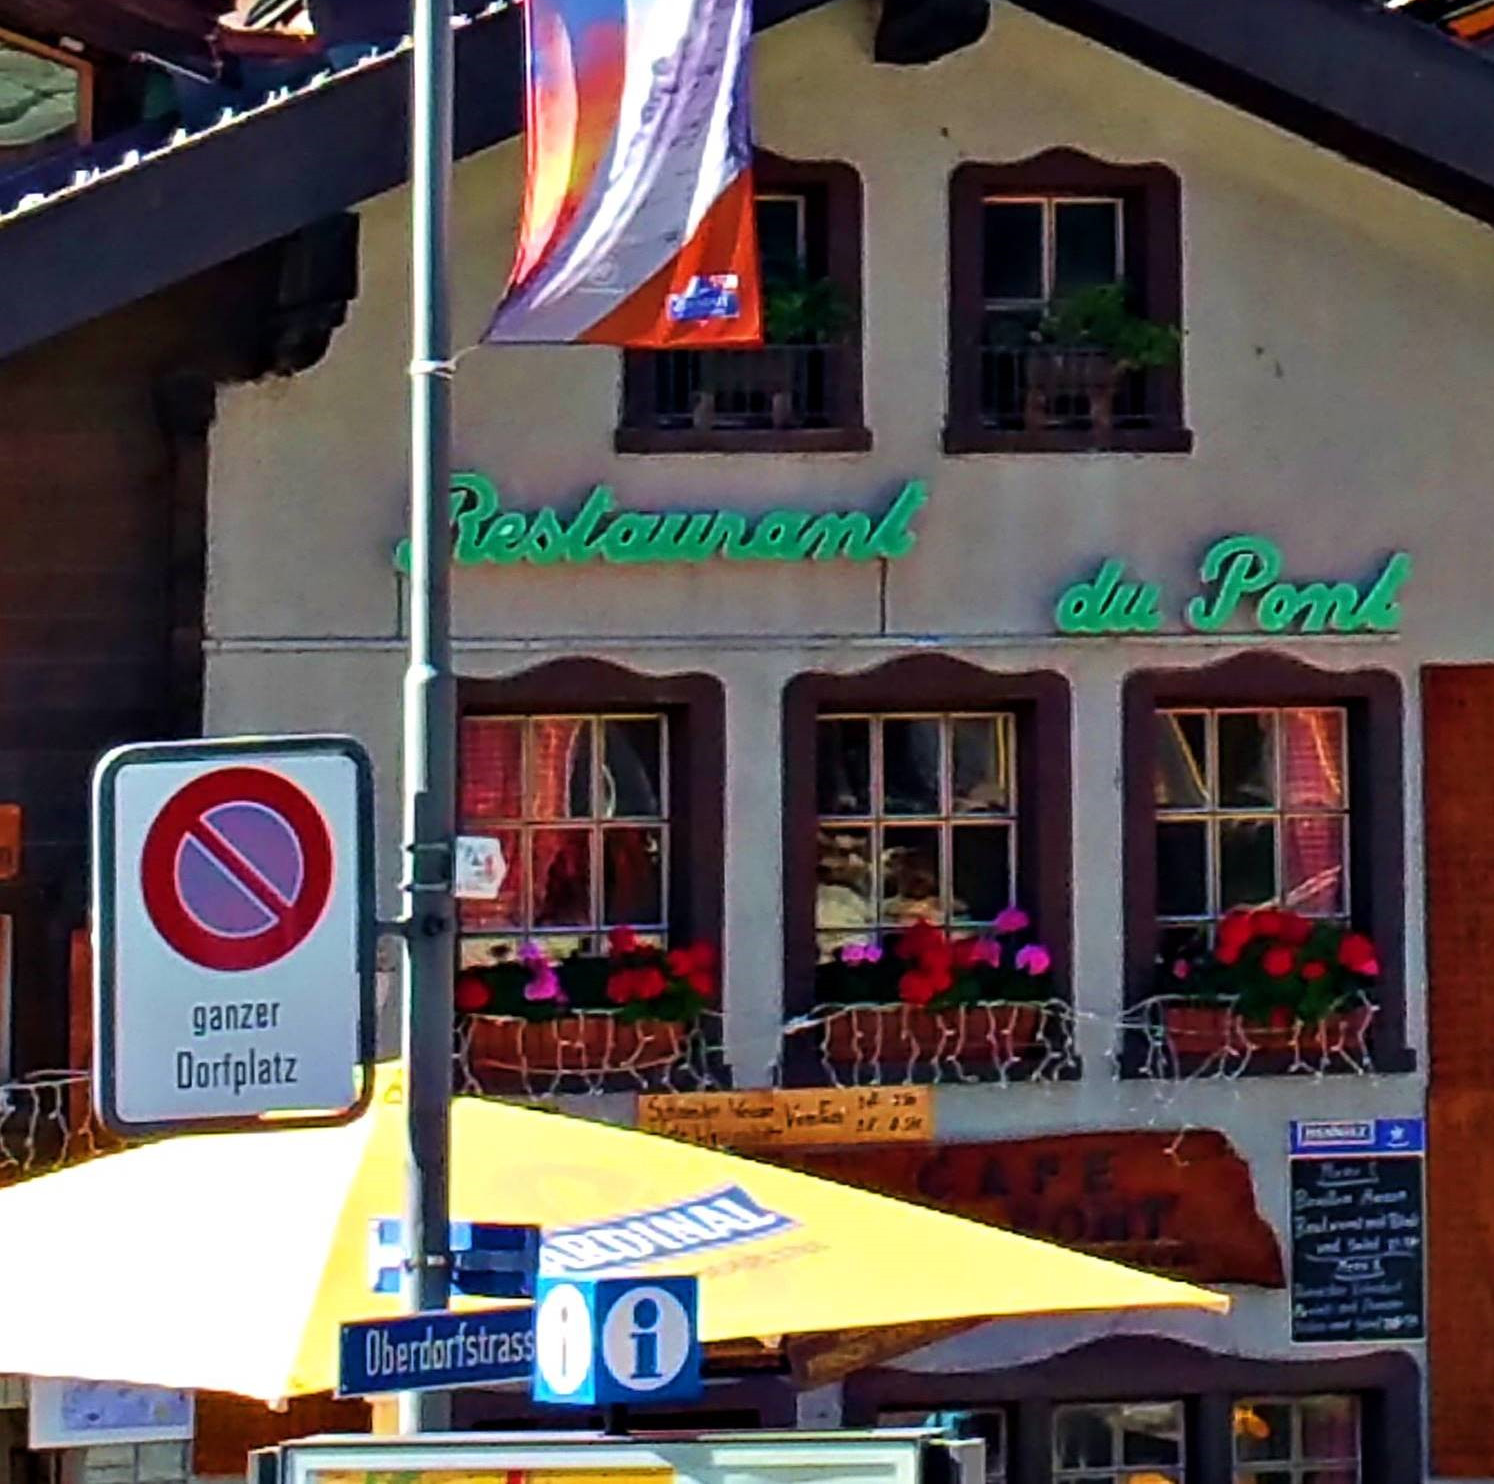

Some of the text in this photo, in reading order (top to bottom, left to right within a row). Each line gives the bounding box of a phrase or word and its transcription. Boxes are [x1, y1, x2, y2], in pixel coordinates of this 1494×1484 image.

[394, 471, 927, 572] Restaurant
[1055, 535, 1412, 632] du Pont
[192, 1001, 281, 1037] ganzer
[176, 1047, 298, 1097] Dorfplatz
[538, 1193, 778, 1277] ARDINAL
[365, 1323, 536, 1377] Oberdorfstrass
